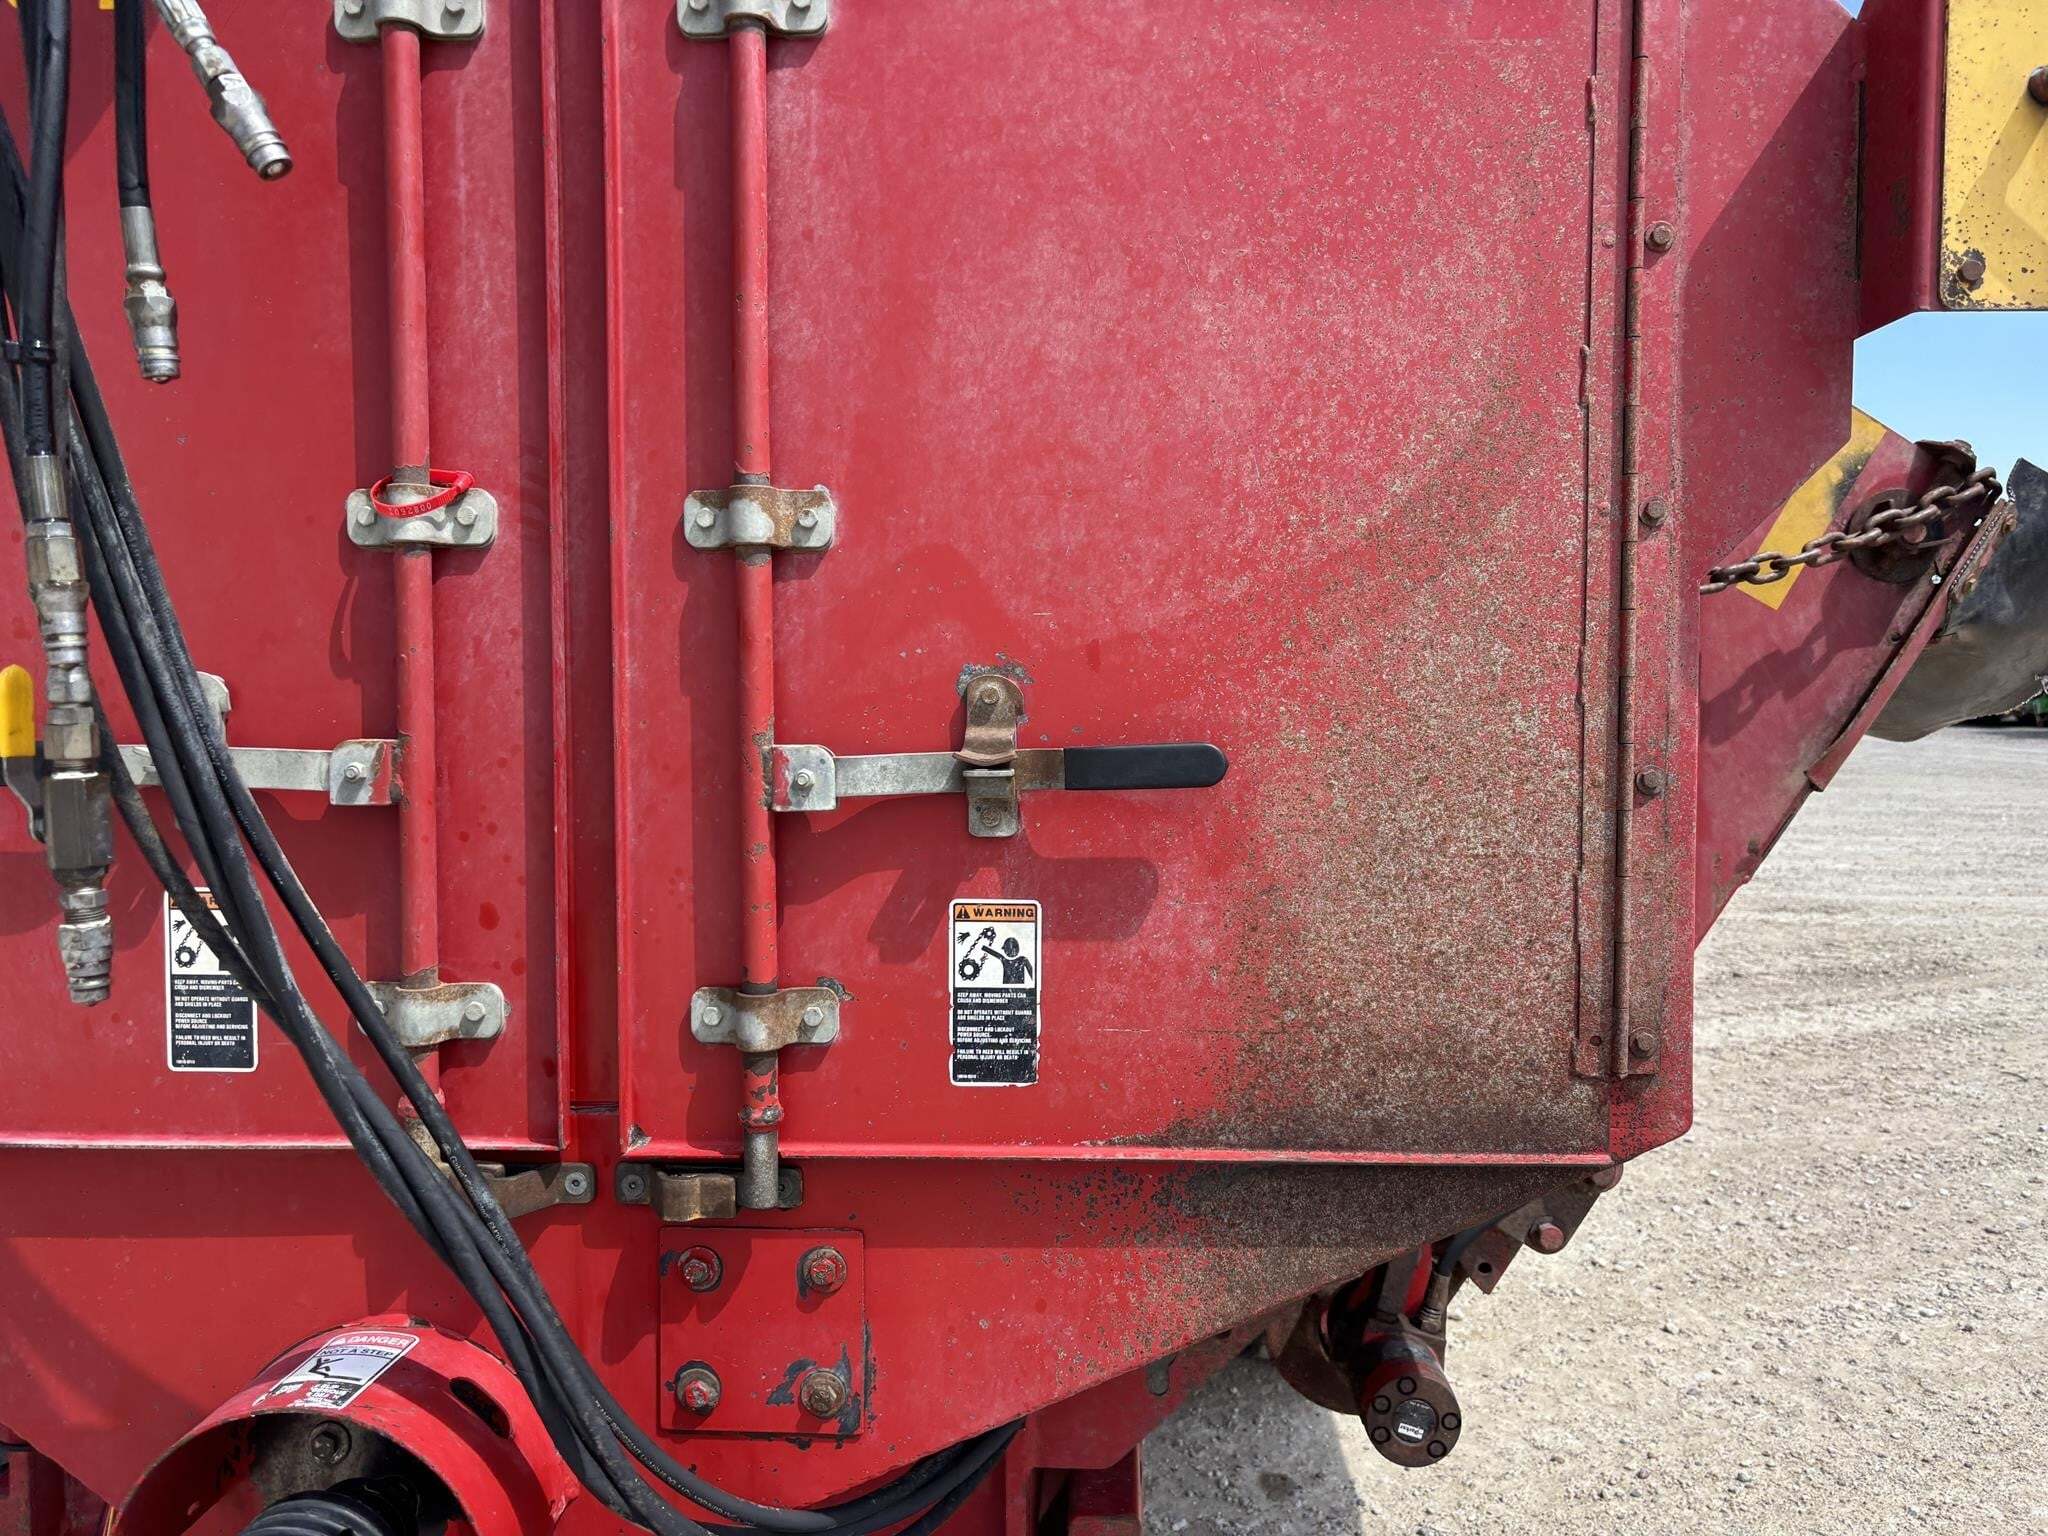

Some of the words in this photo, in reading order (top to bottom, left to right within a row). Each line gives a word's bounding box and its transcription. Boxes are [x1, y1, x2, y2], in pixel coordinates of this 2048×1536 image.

[973, 907, 1034, 918] WARNING
[347, 1335, 410, 1347] DANGER
[359, 1348, 393, 1356] STEP
